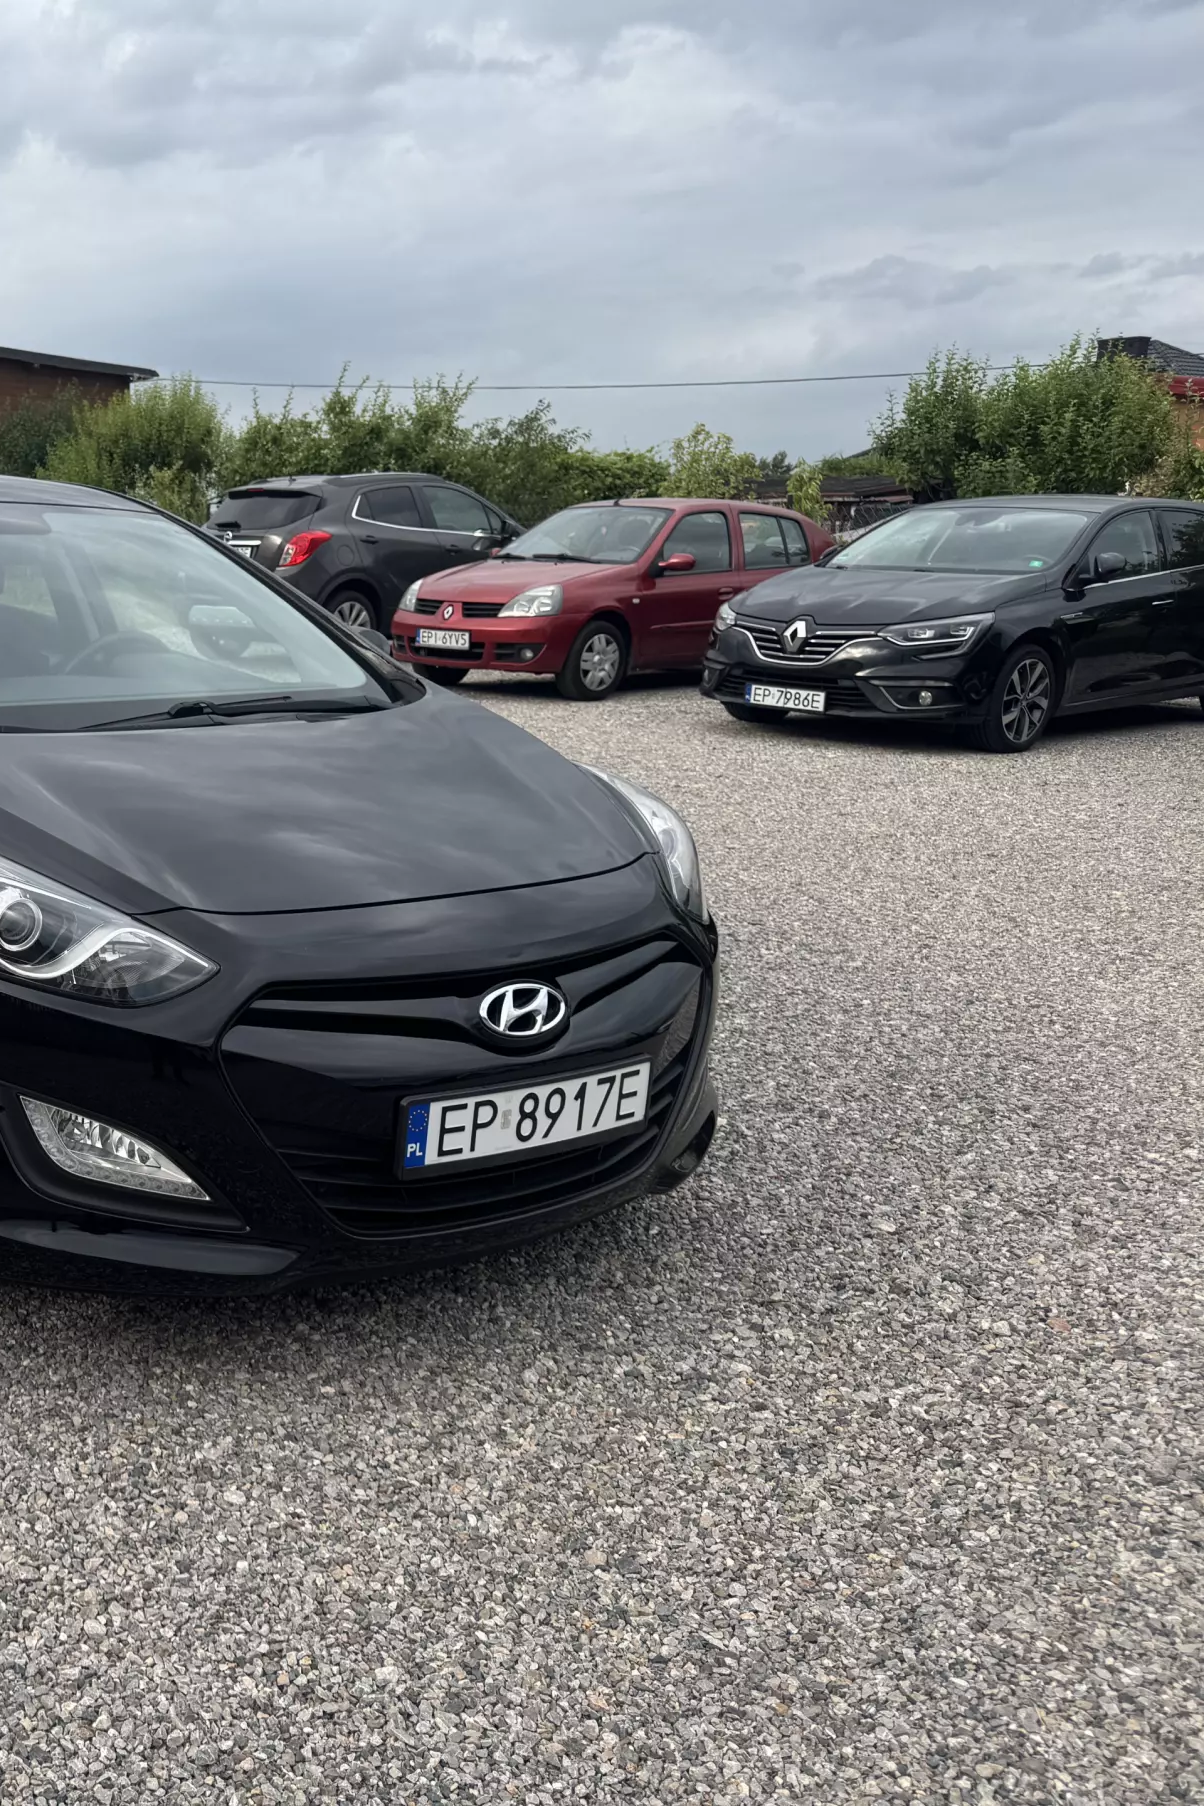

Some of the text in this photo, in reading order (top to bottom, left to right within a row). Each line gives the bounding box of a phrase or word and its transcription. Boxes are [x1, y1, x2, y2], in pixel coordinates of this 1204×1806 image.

[421, 630, 437, 644] EPI
[441, 632, 467, 646] 6YV5
[752, 687, 821, 710] EP 7986E
[436, 1069, 641, 1158] EP 8917E
[406, 1142, 423, 1158] PL
